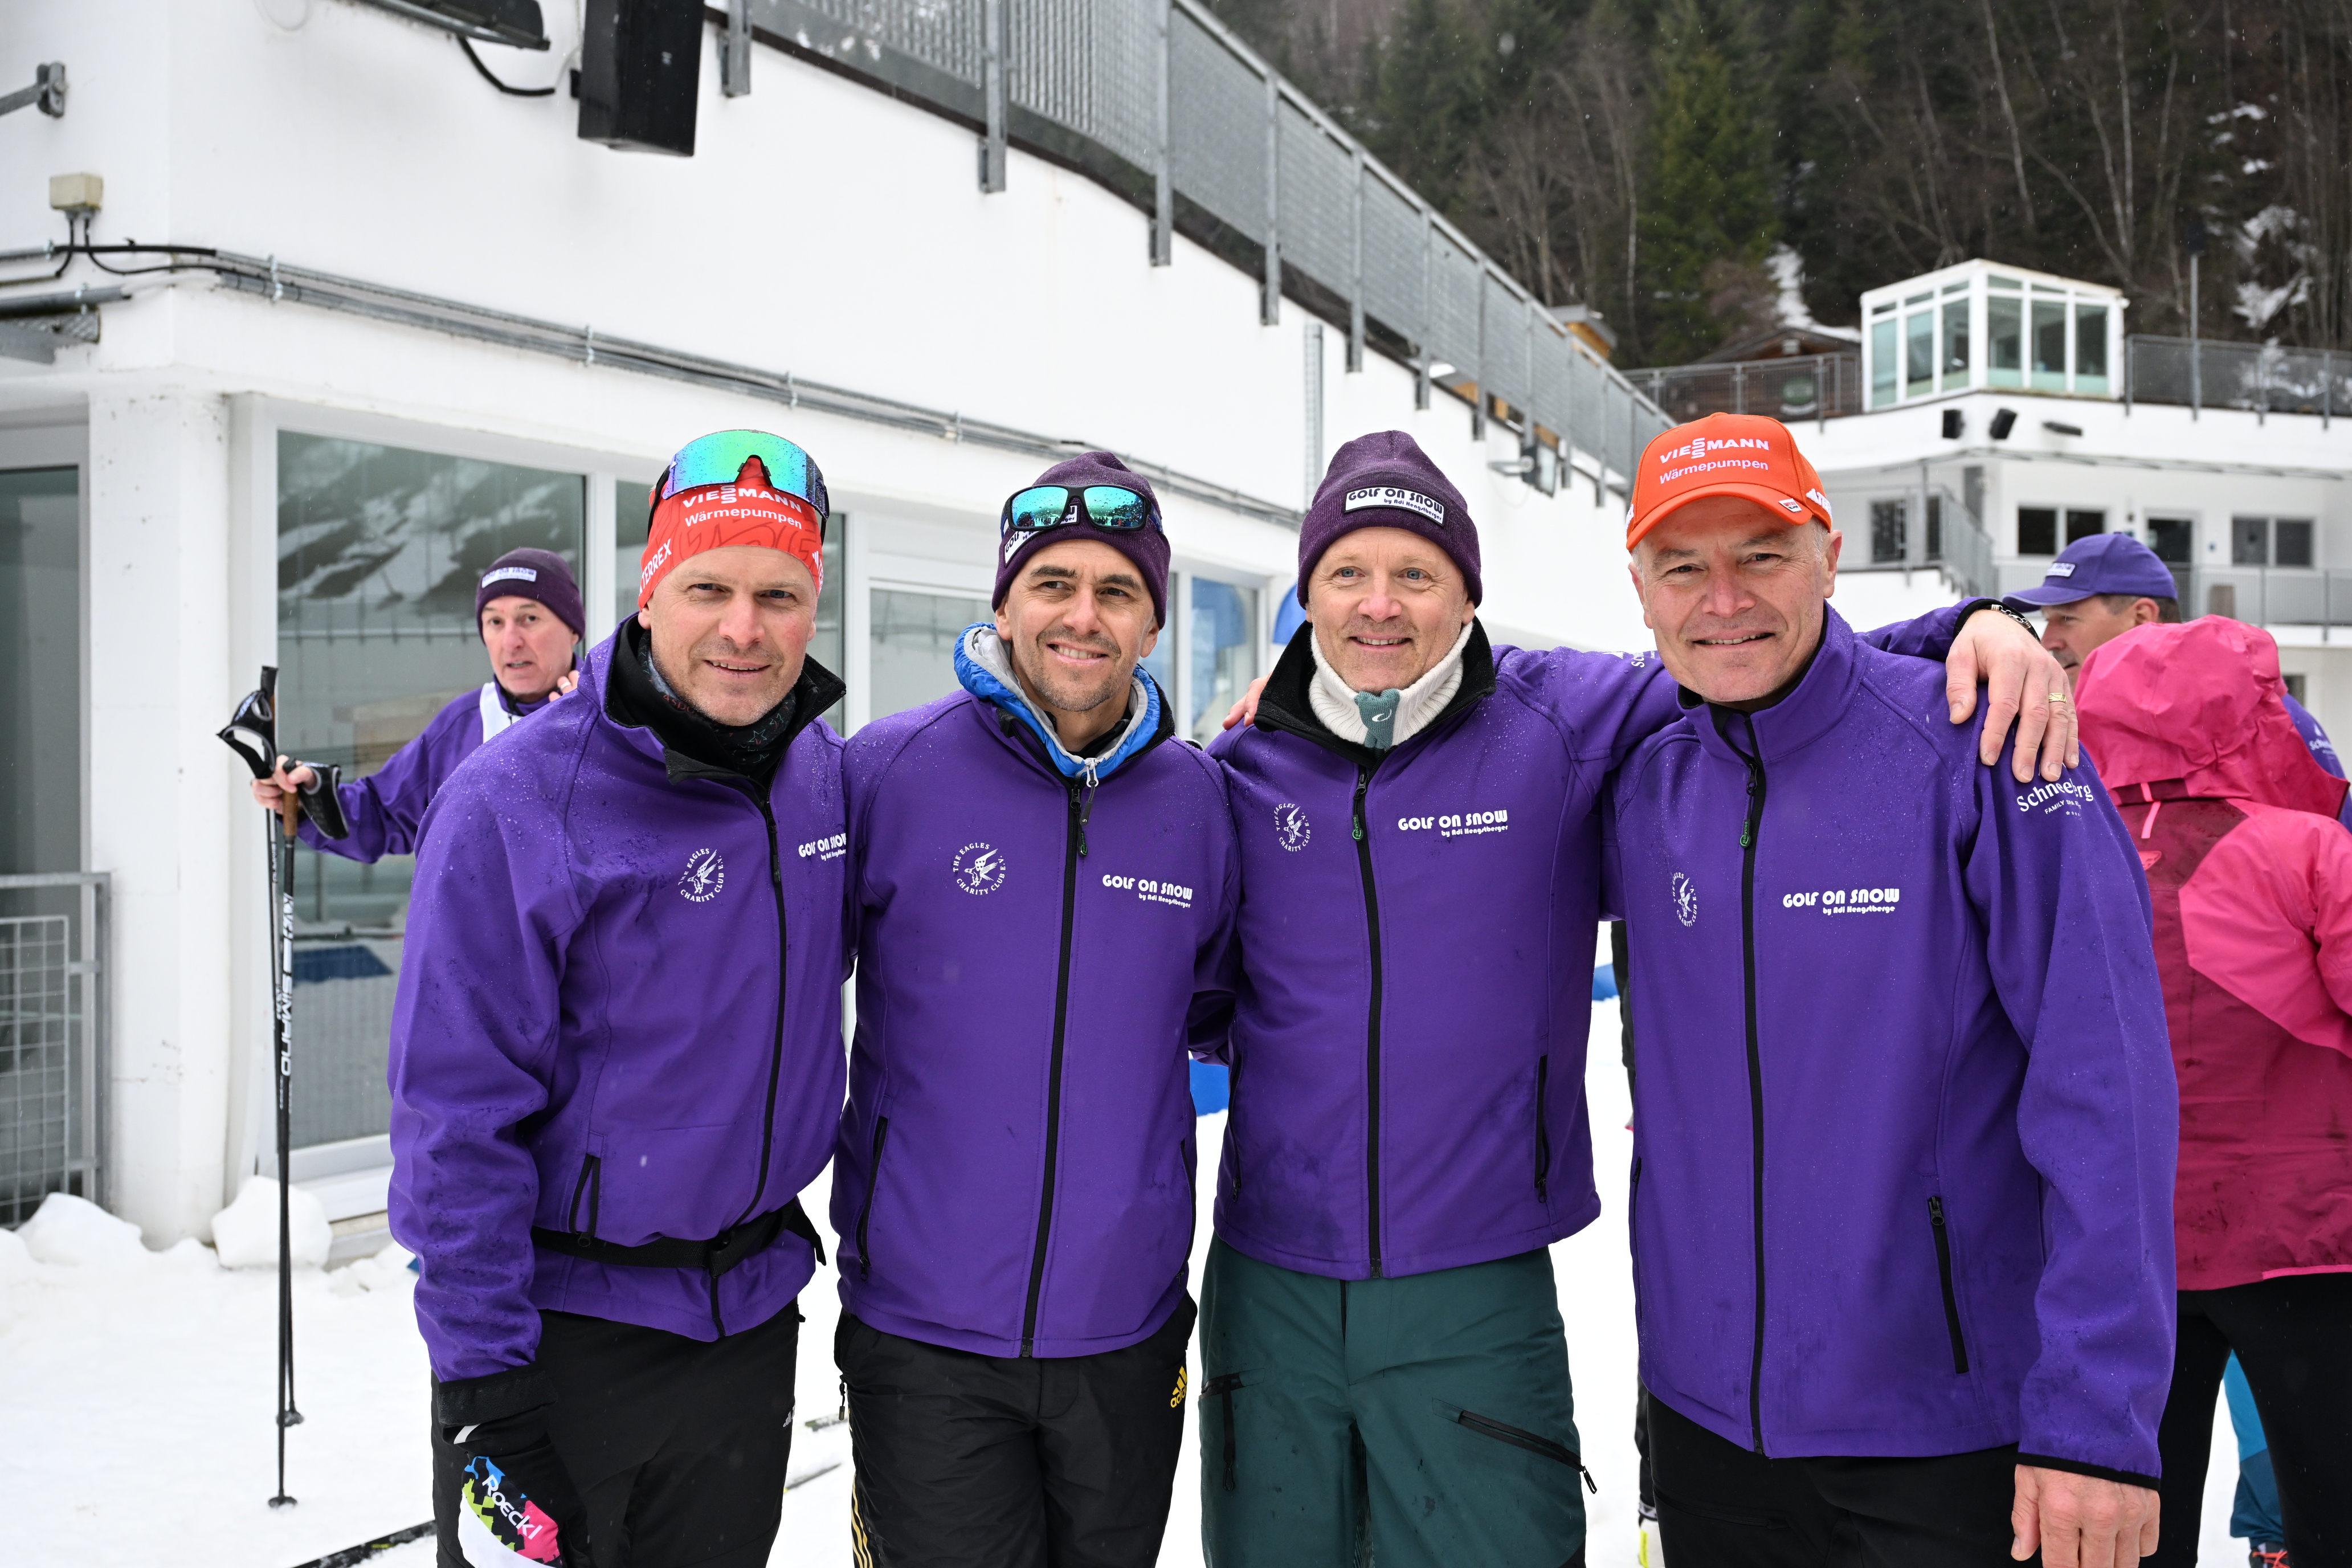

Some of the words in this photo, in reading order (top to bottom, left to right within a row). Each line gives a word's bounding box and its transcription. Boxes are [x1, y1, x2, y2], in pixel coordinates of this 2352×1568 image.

[1659, 459, 1769, 484] Wärmepumpen
[1348, 488, 1381, 501] GOLF
[1385, 488, 1405, 499] ON
[1409, 492, 1443, 514] SNOW
[1406, 501, 1442, 521] Hengstberger
[685, 508, 802, 529] Wärmepumpen
[642, 538, 672, 590] TERREX
[1273, 803, 1295, 815] EAGLES
[2044, 800, 2064, 814] FAMILY
[1398, 816, 1435, 831] GOLF
[1439, 815, 1461, 828] ON
[1465, 810, 1508, 826] SNOW
[1279, 837, 1301, 852] CHARITY
[1302, 829, 1310, 847] CLUB
[687, 848, 710, 868] EAGLES
[953, 855, 961, 872] THE
[959, 842, 990, 855] EAGLES
[680, 889, 715, 902] CHARITY
[714, 872, 724, 893] CLUB
[957, 878, 989, 895] CHARITY
[991, 873, 1005, 891] CLUB
[1102, 874, 1136, 889] GOLF
[1138, 879, 1158, 893] ON
[1161, 882, 1193, 900] SNOW
[1783, 892, 1819, 908] GOLF
[1822, 890, 1845, 905] ON
[1849, 888, 1900, 904] SNOW
[1823, 907, 1832, 916] by
